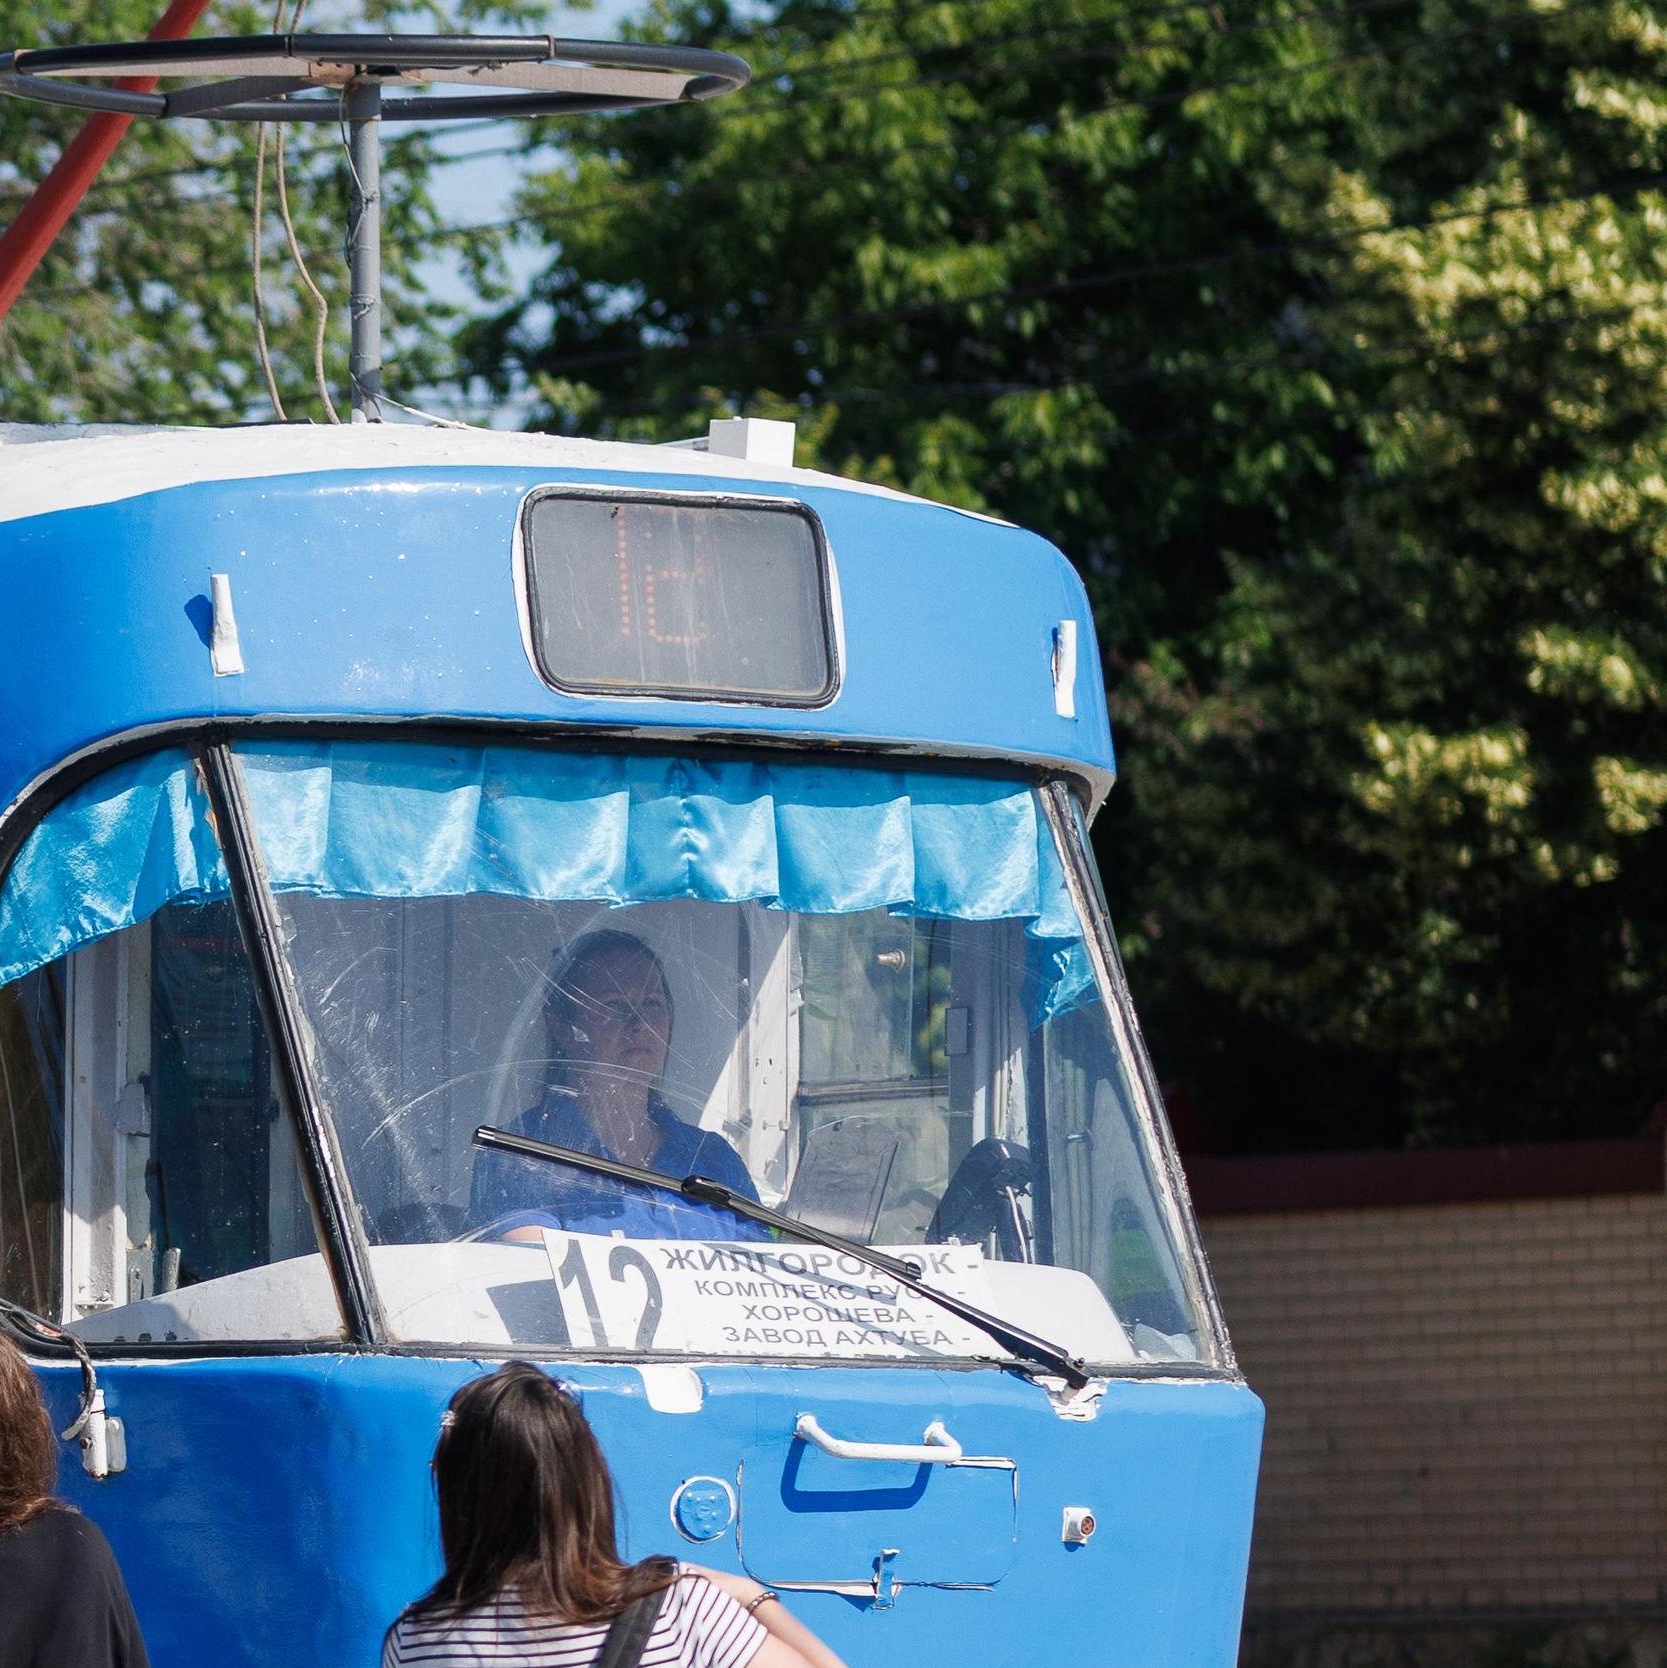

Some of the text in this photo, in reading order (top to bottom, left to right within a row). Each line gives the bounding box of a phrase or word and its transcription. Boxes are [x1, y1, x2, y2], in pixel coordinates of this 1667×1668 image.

[659, 1246, 955, 1279] ЖИЛГОРООК
[558, 1238, 663, 1352] 12
[693, 1279, 857, 1301] КОМПЛЕКС
[741, 1303, 916, 1324] ХОРОШЕВА
[722, 1325, 829, 1348] ЗАВОД
[835, 1329, 954, 1347] АХТУБА
